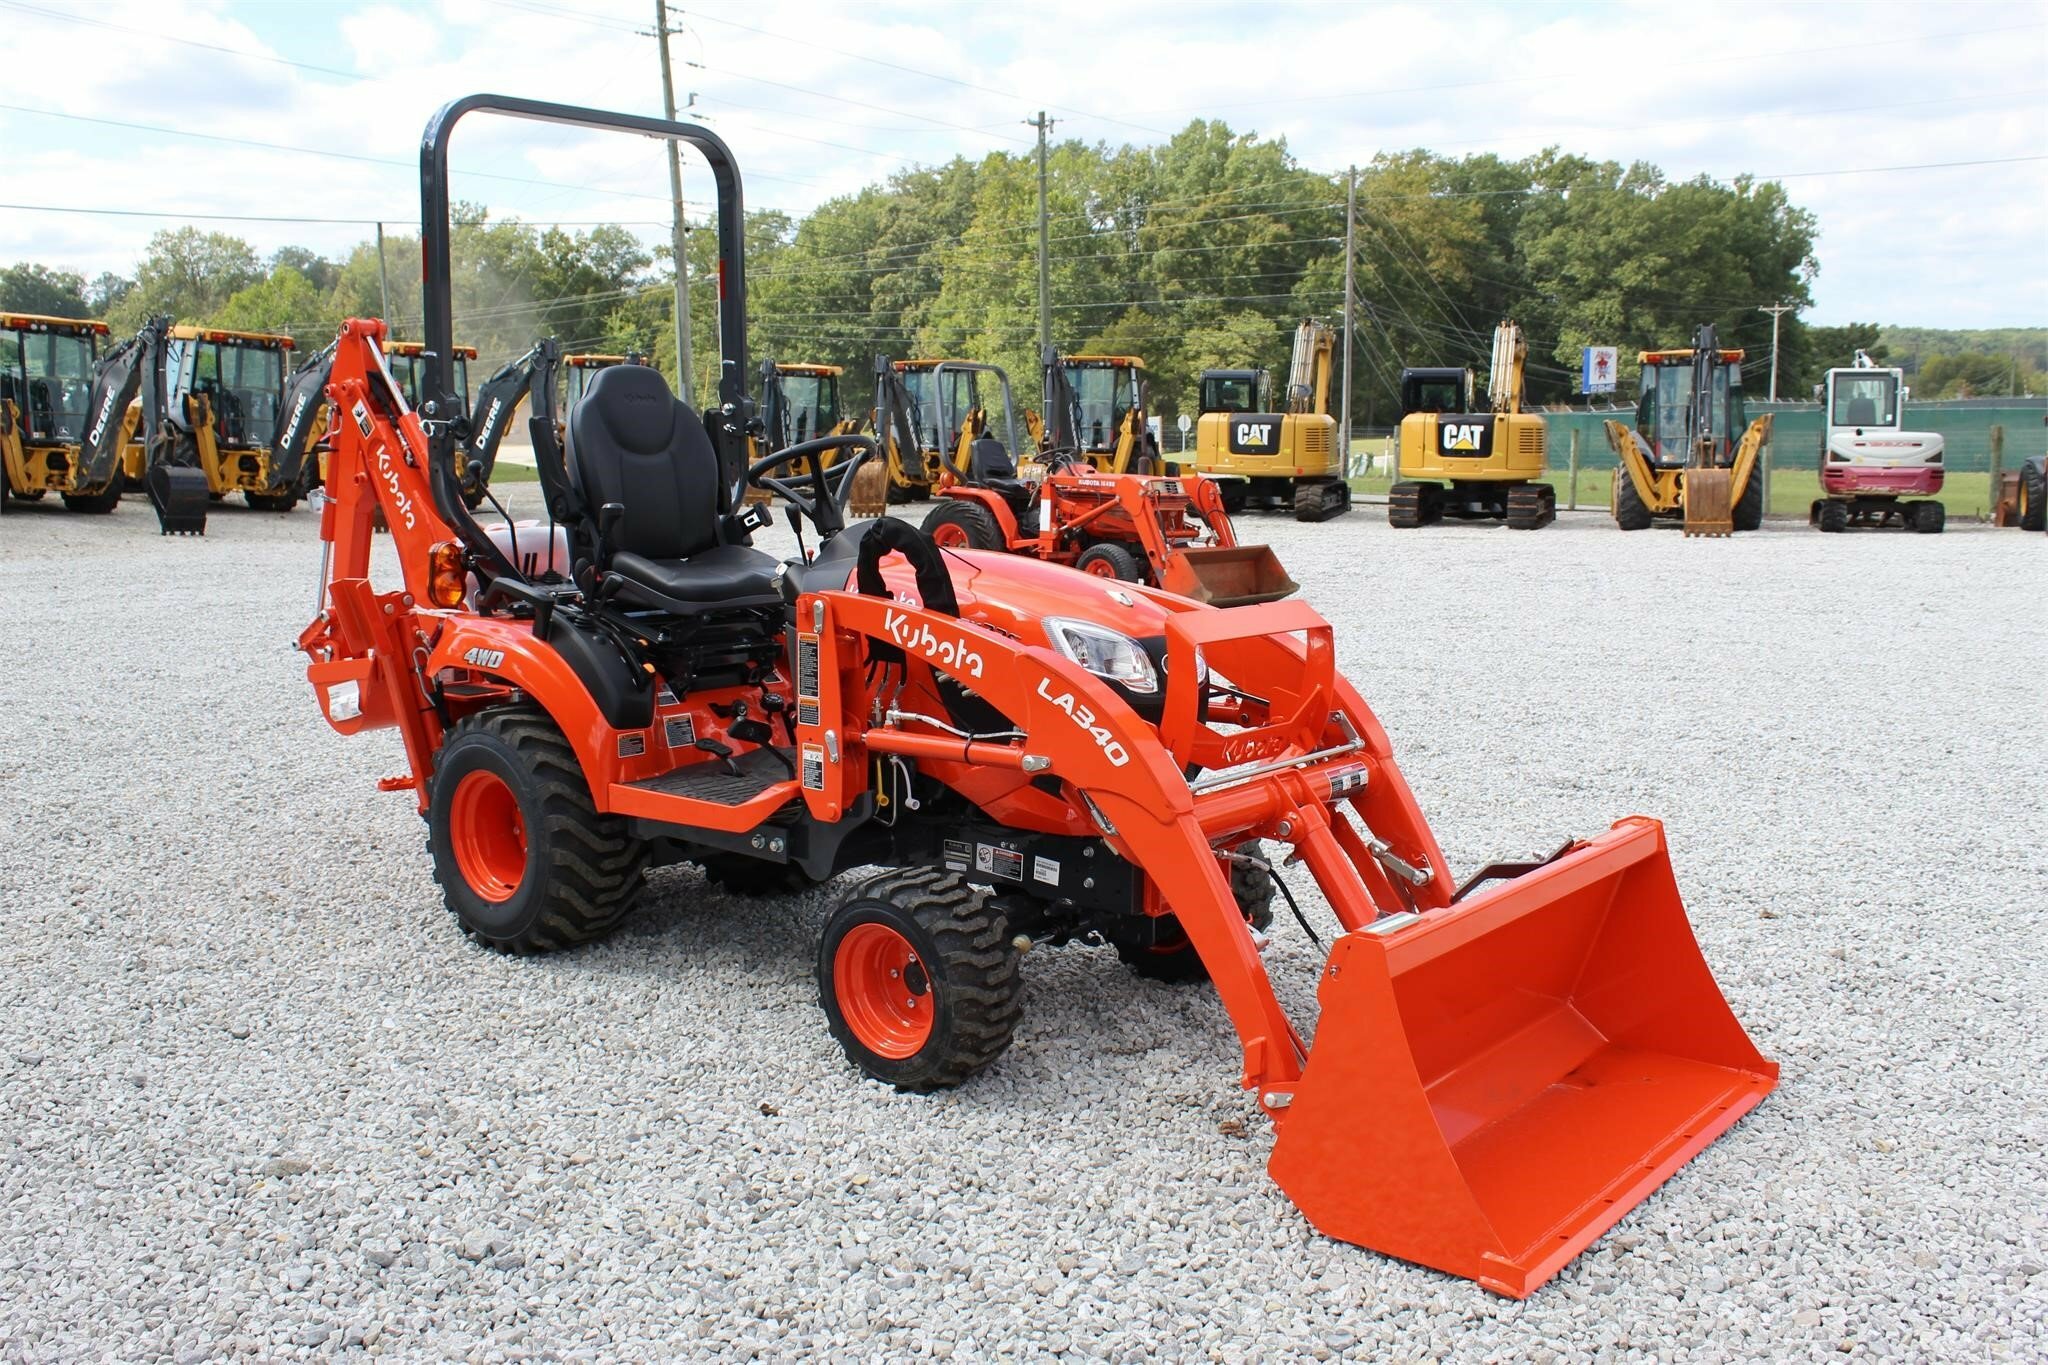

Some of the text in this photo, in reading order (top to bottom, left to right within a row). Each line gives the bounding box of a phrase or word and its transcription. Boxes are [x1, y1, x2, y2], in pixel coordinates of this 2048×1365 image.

[88, 386, 117, 447] DEERE
[280, 392, 307, 450] DEERE
[475, 397, 502, 450] DEERE
[1237, 423, 1271, 446] CAT
[1443, 423, 1485, 450] CAT
[376, 444, 415, 530] Kubota
[463, 646, 505, 669] 4WD
[883, 607, 984, 679] Kubota
[1037, 677, 1130, 768] LA340
